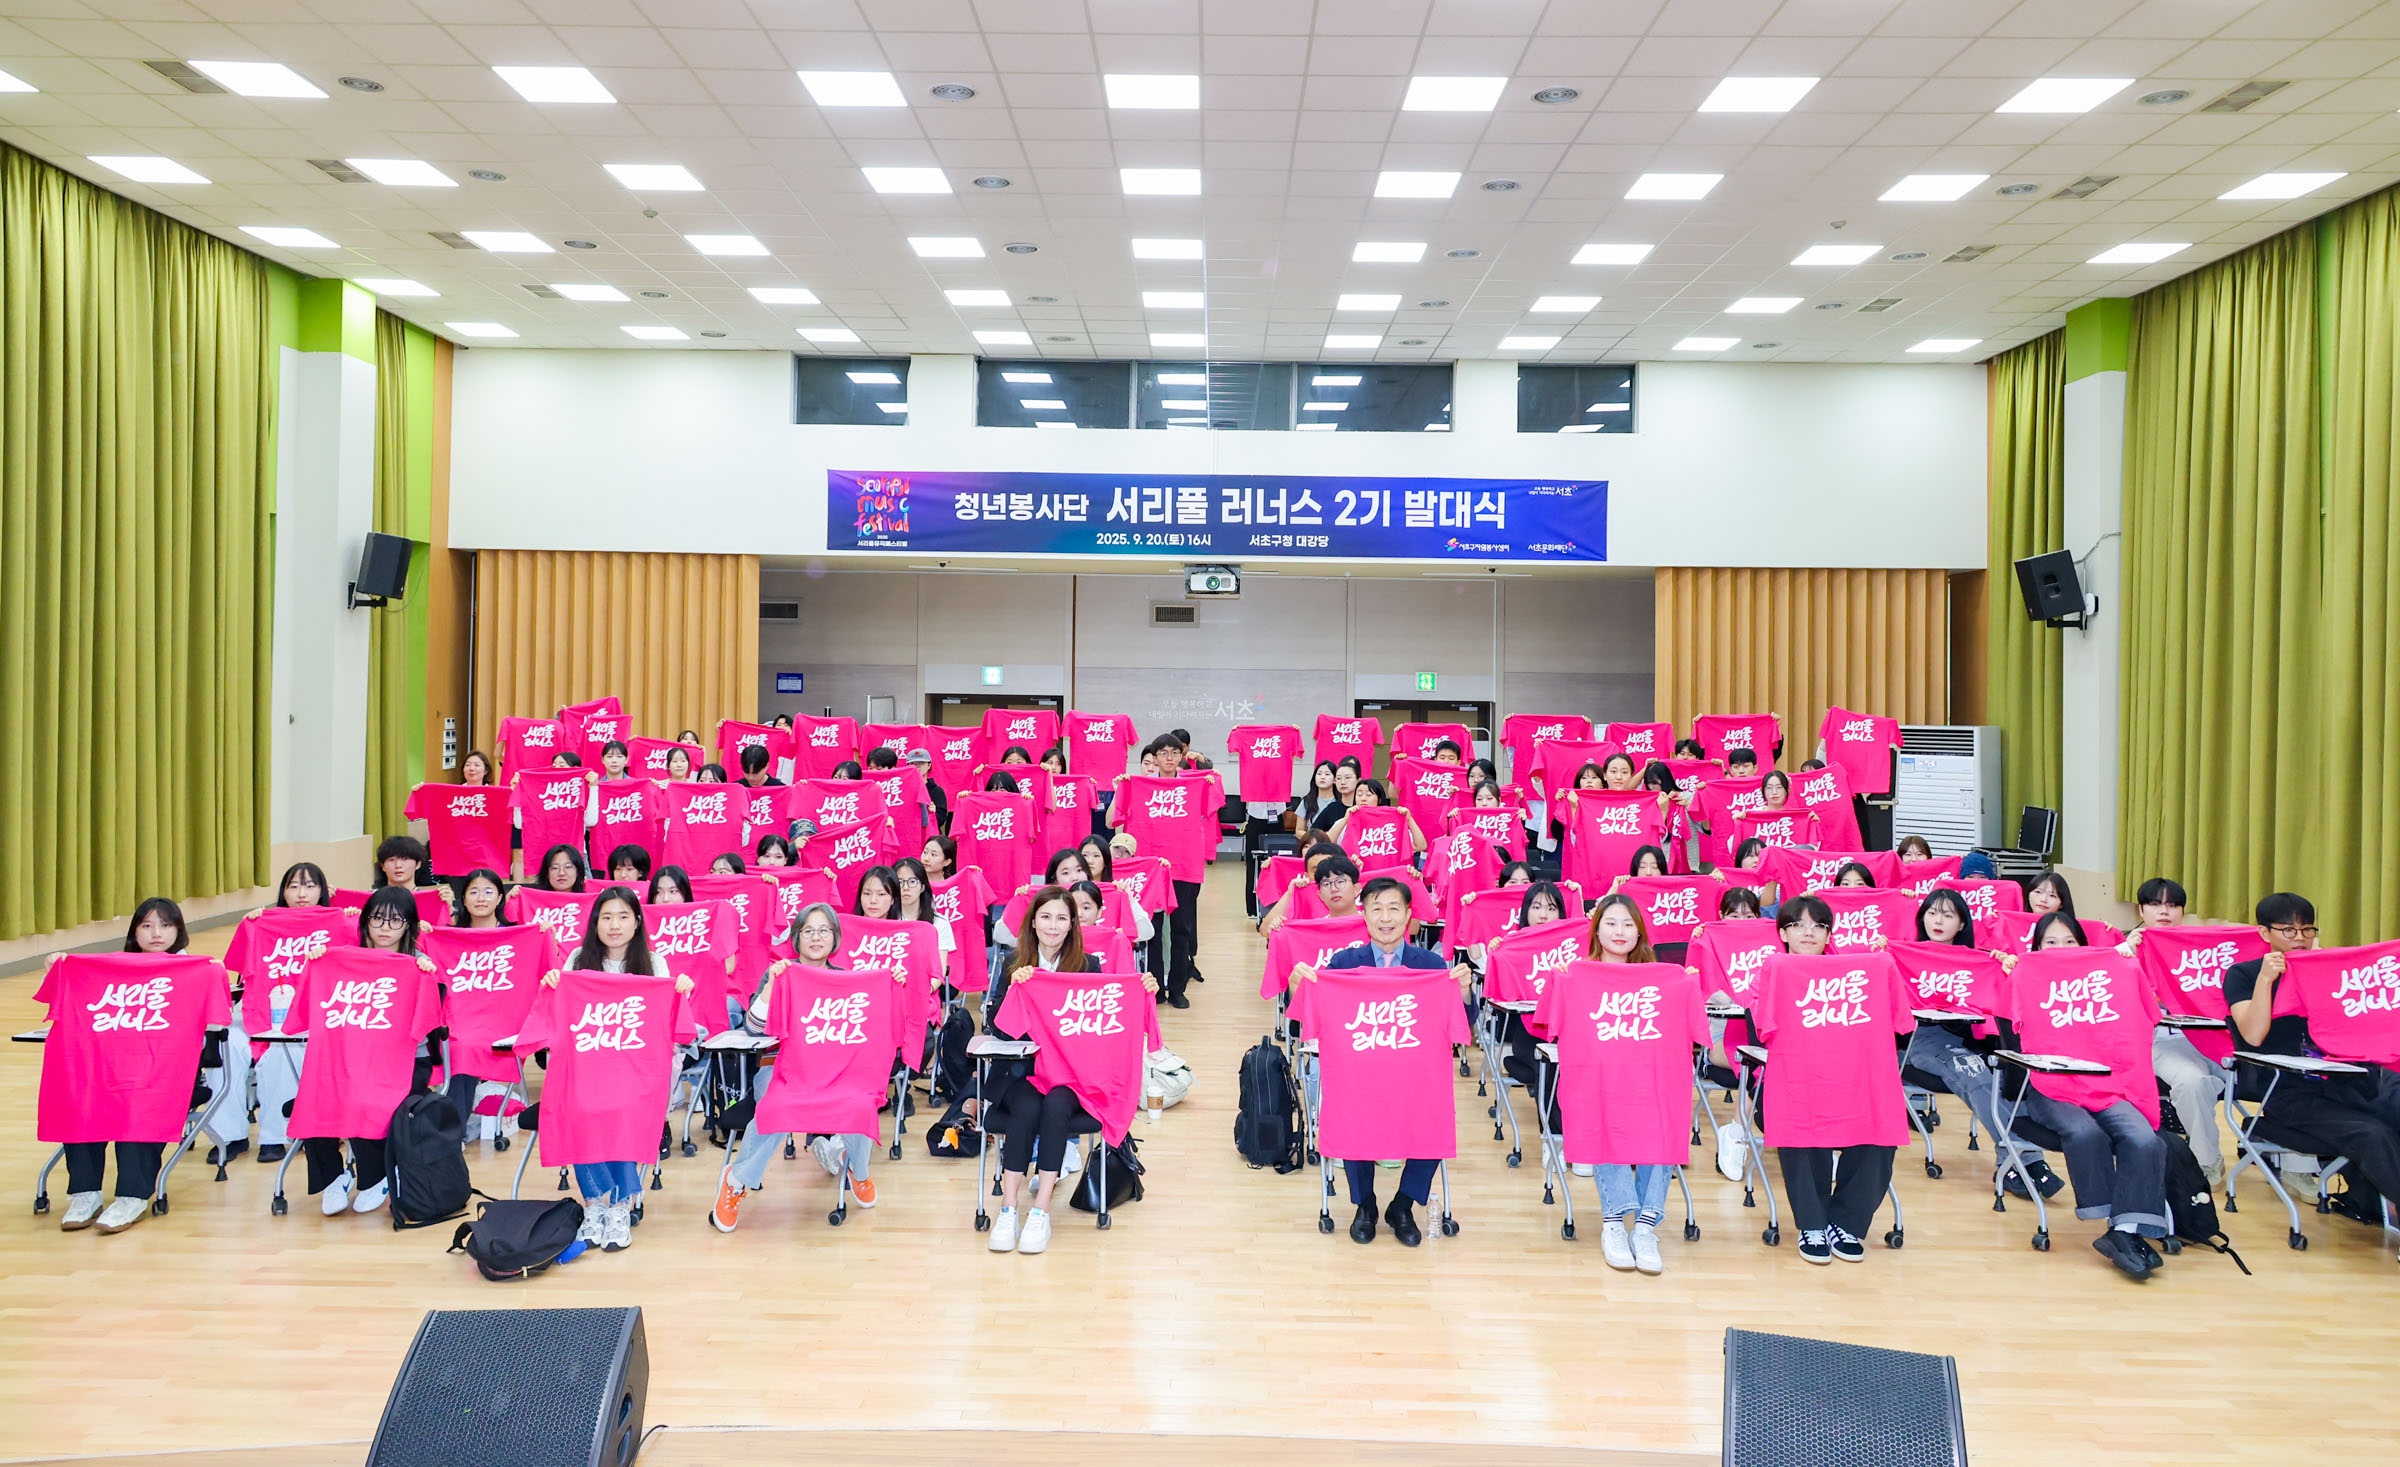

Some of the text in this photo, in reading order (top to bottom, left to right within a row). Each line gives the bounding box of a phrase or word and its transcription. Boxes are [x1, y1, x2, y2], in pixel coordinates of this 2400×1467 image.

[1556, 486, 1572, 496] 서초
[955, 487, 1506, 529] 청년봉사단 서리풀 러너스 2기 발대식
[854, 512, 910, 537] festival
[1096, 534, 1130, 544] 2025.
[1133, 534, 1142, 545] 9.
[1187, 534, 1211, 546] 16시
[1249, 534, 1329, 548] 서초구청 대강당
[1458, 543, 1510, 552] 서초구자원봉사센터
[1528, 544, 1568, 554] 서초문화재단
[1214, 700, 1256, 720] 서초
[522, 724, 555, 738] 서리풀
[586, 721, 618, 734] 서리풀
[810, 724, 840, 738] 서리풀
[1006, 716, 1037, 730] 서리풀
[1084, 720, 1114, 733] 서리풀
[1331, 721, 1362, 735] 서리풀
[1532, 724, 1564, 738] 서리풀
[1840, 719, 1874, 733] 서리풀
[1250, 735, 1282, 751] 서리풀
[1623, 730, 1656, 745] 서리풀
[1721, 726, 1752, 743] 서리풀
[942, 738, 972, 753] 서리풀
[539, 777, 583, 799] 서리풀
[1056, 782, 1076, 798] 리풀
[1415, 772, 1454, 788] 서리풀
[1800, 773, 1836, 796] 서리풀
[447, 794, 487, 808] 서리풀
[602, 792, 642, 813] 서리풀
[682, 792, 728, 813] 서리풀
[750, 796, 772, 812] 리풀
[816, 792, 860, 813] 서리풀
[1145, 786, 1187, 806] 서리풀
[1805, 790, 1841, 806] 러너스
[606, 810, 642, 824] 러너스
[686, 810, 727, 824] 러너스
[972, 808, 1014, 828] 서리풀
[1149, 803, 1188, 818] 러너스
[1596, 804, 1642, 822] 서리풀
[976, 825, 1014, 840] 러너스
[1474, 812, 1512, 832] 서리풀
[1600, 821, 1642, 835] 러너스
[830, 826, 871, 858] 서리풀
[1358, 823, 1397, 843] 서리풀
[835, 846, 876, 870] 러너스
[1360, 840, 1398, 858] 러너스
[932, 886, 961, 909] 리풀
[1648, 887, 1700, 912] 서리풀
[1961, 885, 1997, 908] 리풀
[650, 908, 710, 940] 서리풀
[1652, 910, 1700, 926] 러너스
[1832, 904, 1882, 934] 서리풀
[655, 935, 710, 956] 러너스
[848, 932, 910, 959] 서리풀
[268, 958, 306, 979] 러너
[446, 944, 515, 975] 서리풀
[1526, 938, 1582, 980] 서리풀
[2171, 941, 2240, 975] 서리풀
[452, 971, 514, 992] 러너스
[1796, 970, 1869, 1008] 서리풀
[2040, 970, 2113, 1010] 서리풀
[2179, 968, 2225, 992] 러너
[86, 978, 174, 1011] 서리풀
[320, 978, 398, 1009] 서리풀
[1052, 982, 1124, 1017] 서리풀
[1590, 986, 1662, 1020] 서리풀
[326, 1006, 392, 1030] 러너스
[570, 996, 646, 1032] 서리풀
[801, 992, 870, 1024] 서리풀
[1345, 994, 1418, 1031] 서리풀
[1802, 1002, 1872, 1028] 러너스
[2050, 1000, 2120, 1028] 러너스
[92, 1008, 170, 1032] 러너스
[1059, 1013, 1125, 1037] 러너스
[1596, 1017, 1662, 1042] 러너스
[576, 1027, 646, 1052] 러너스
[805, 1022, 868, 1045] 러너스
[1352, 1026, 1420, 1052] 러너스
